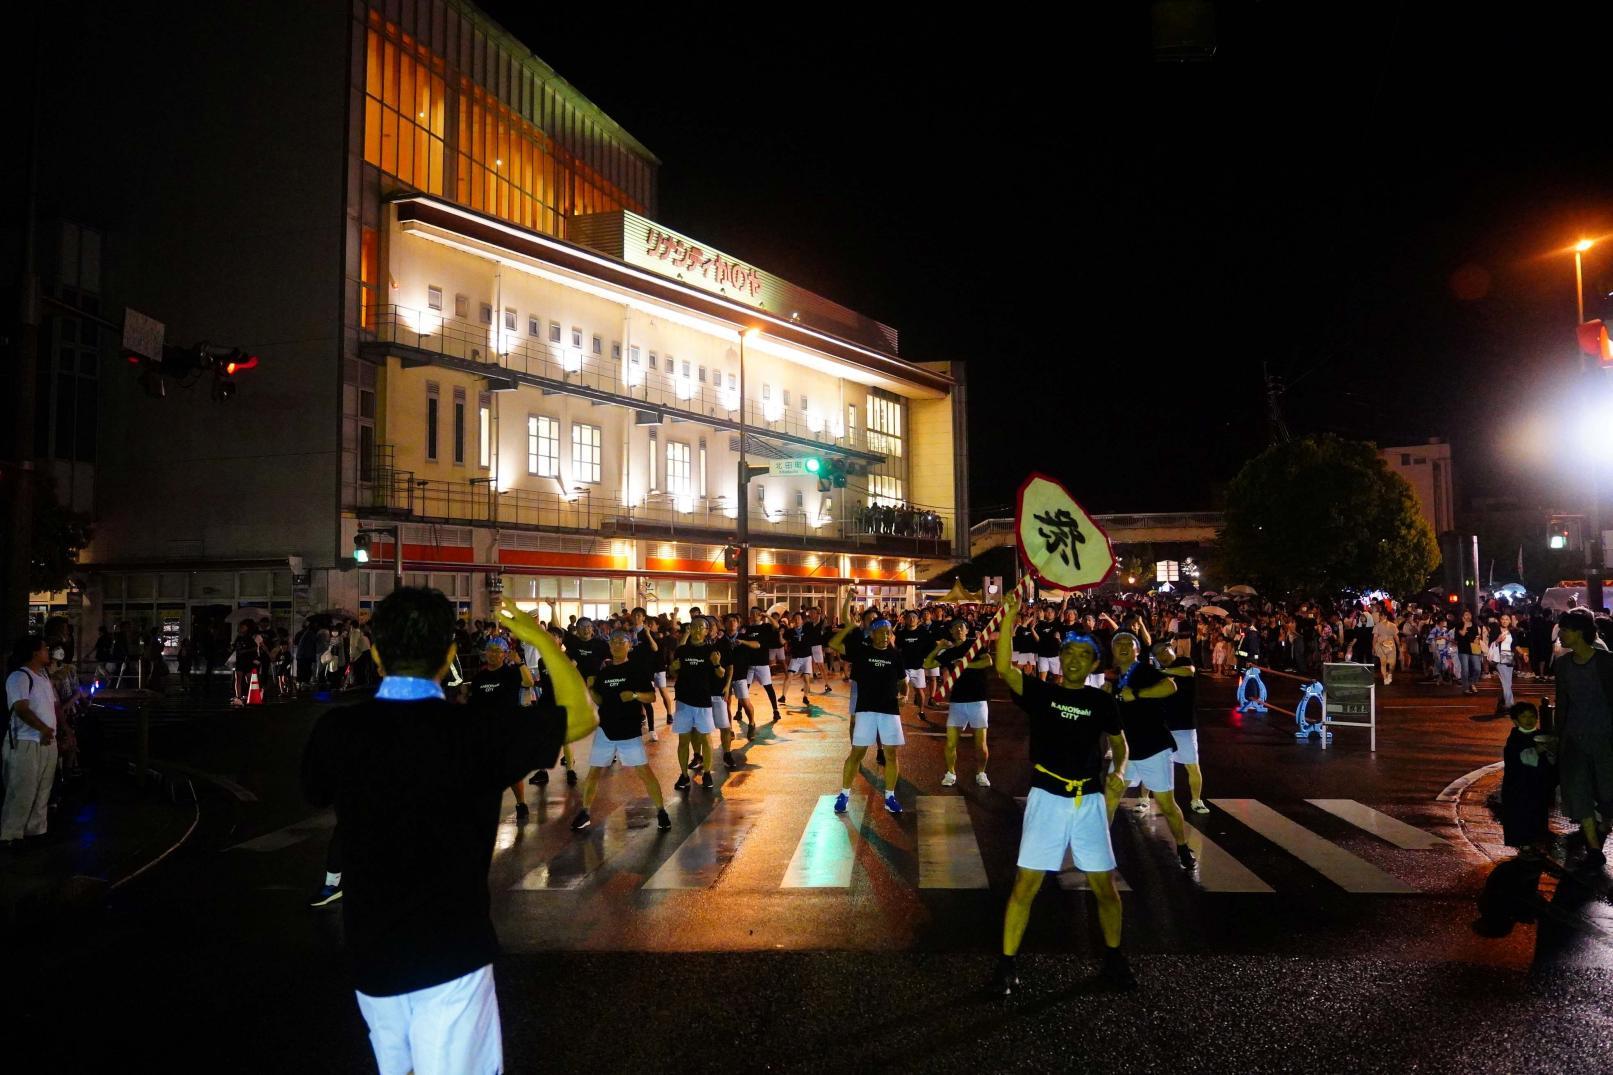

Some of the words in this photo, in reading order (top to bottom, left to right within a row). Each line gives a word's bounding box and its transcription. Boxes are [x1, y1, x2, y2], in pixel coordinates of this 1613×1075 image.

[645, 228, 761, 297] リナシティかのや
[1060, 711, 1080, 721] CITY
